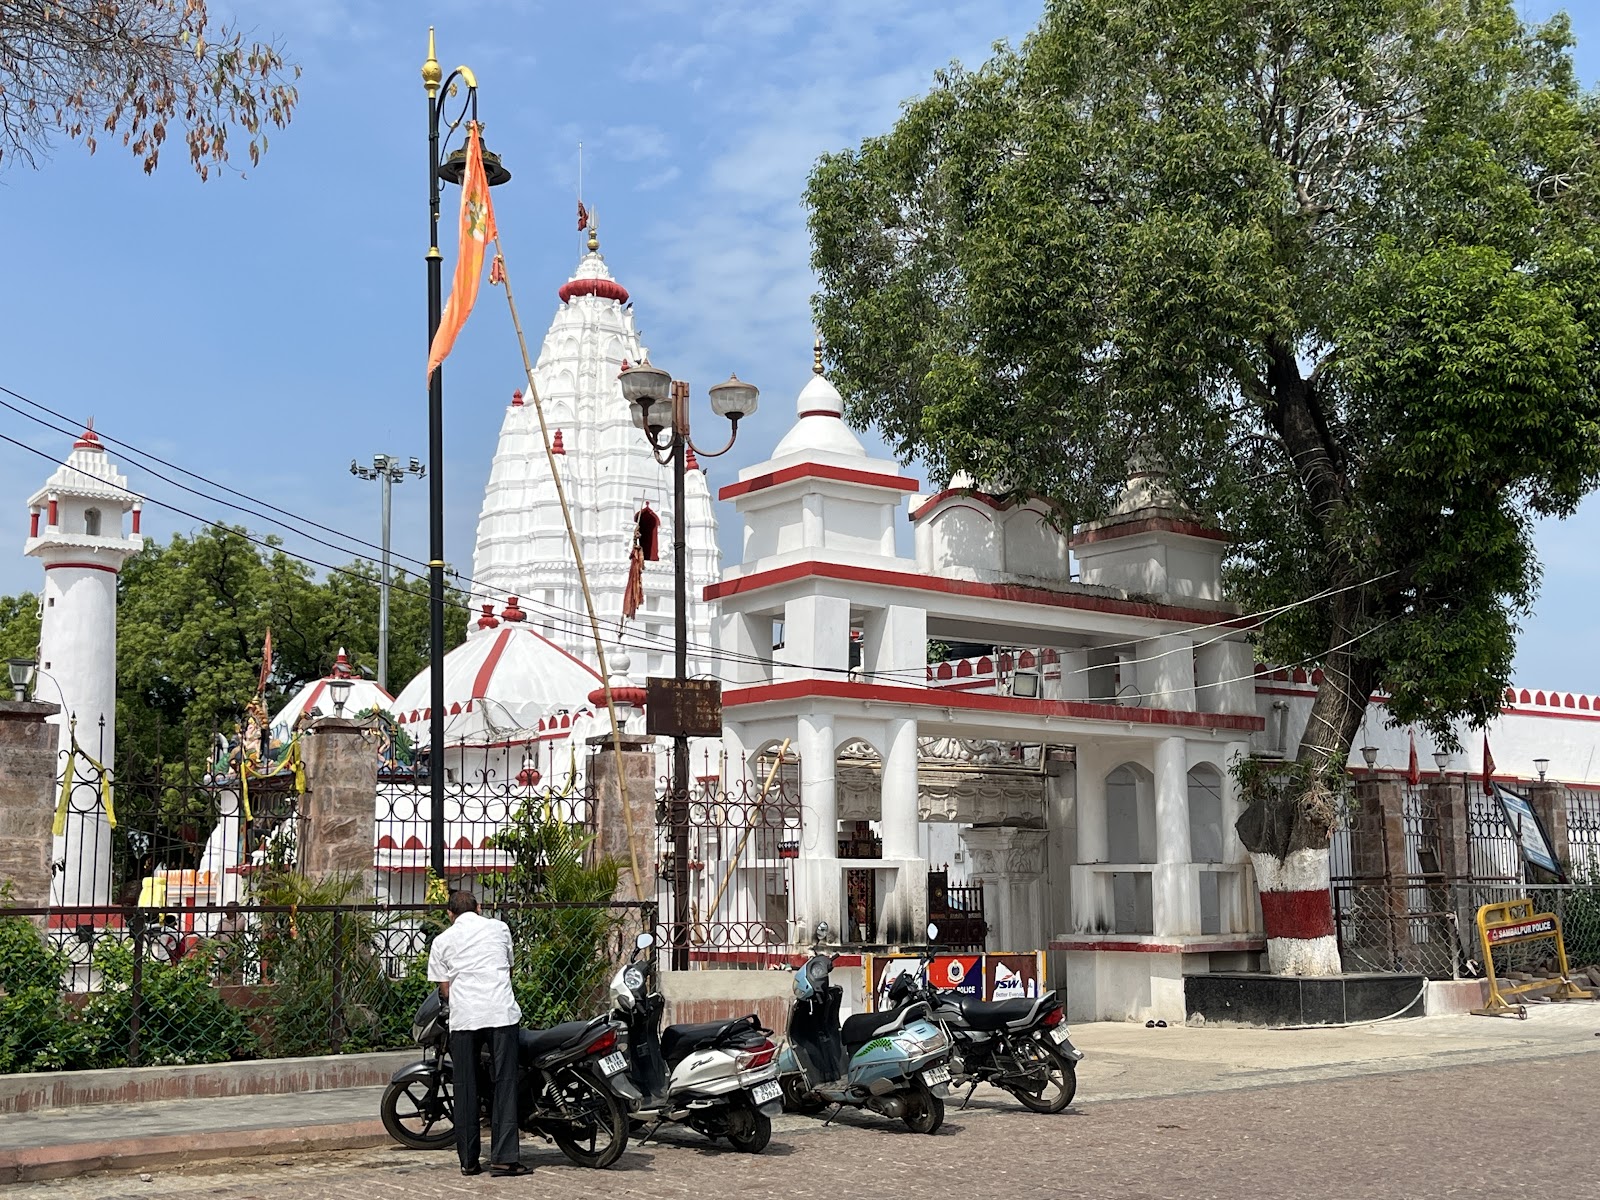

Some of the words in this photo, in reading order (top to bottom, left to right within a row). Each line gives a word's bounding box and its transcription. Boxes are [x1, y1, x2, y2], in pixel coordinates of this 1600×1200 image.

[1498, 924, 1532, 938] SAMBALPUR
[1532, 921, 1551, 932] POLICE
[956, 985, 976, 994] POLICE
